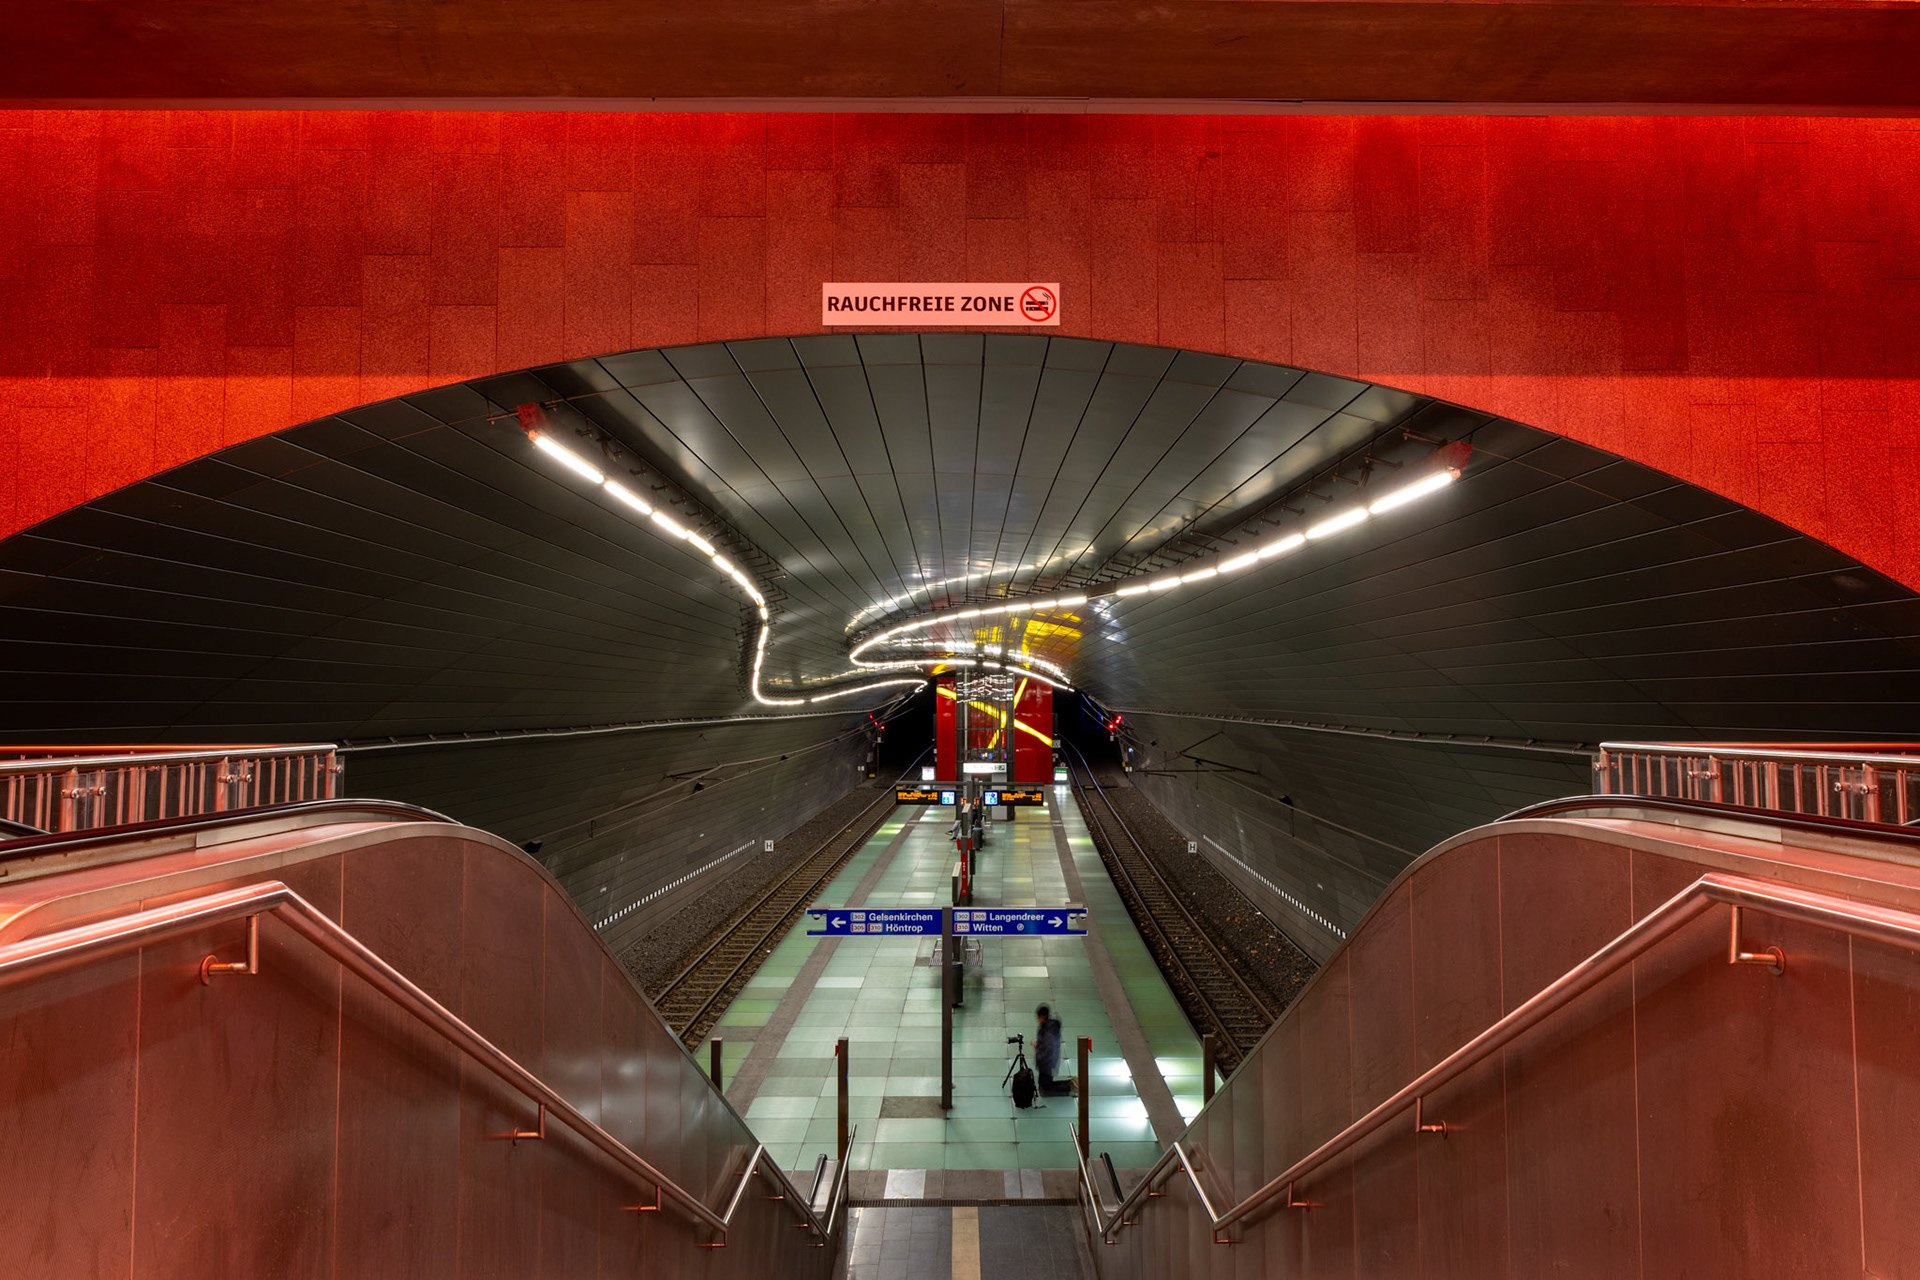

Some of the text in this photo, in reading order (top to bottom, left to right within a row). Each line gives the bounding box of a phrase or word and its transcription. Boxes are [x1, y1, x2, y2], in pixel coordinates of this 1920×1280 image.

[828, 296, 1014, 312] RAUCHFREIE ZONE
[869, 913, 933, 921] Gelsenkirchen
[990, 913, 1044, 922] Langendreer
[886, 923, 923, 933] Höntrop
[973, 923, 1003, 932] Witten
